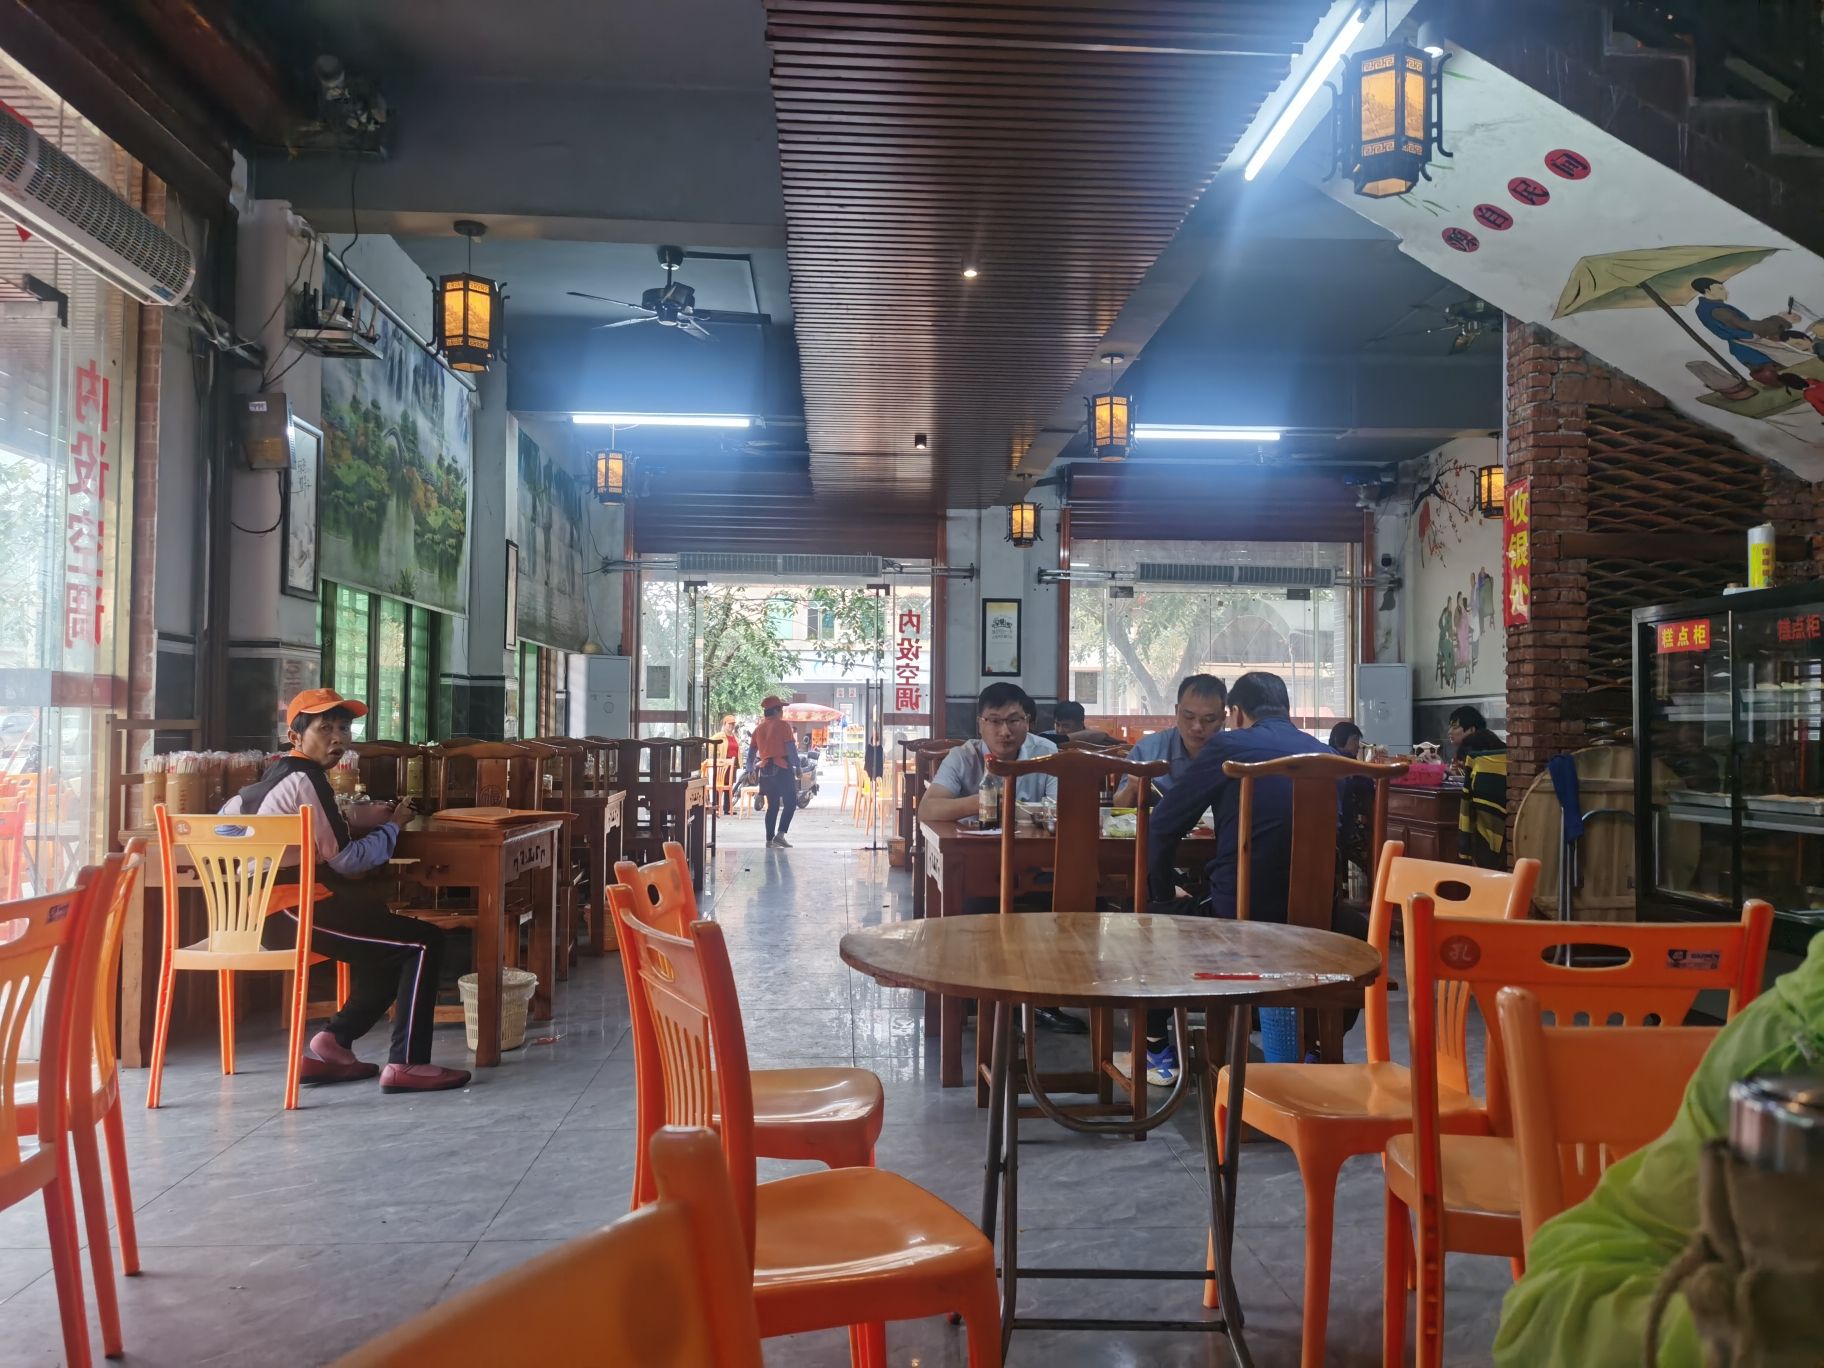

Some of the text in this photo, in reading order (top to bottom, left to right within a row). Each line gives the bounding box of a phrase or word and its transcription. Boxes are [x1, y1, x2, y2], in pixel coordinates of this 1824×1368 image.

[1508, 487, 1529, 618] 收银处
[1661, 624, 1706, 648] 糕点柜
[1777, 614, 1821, 642] 糕点柜
